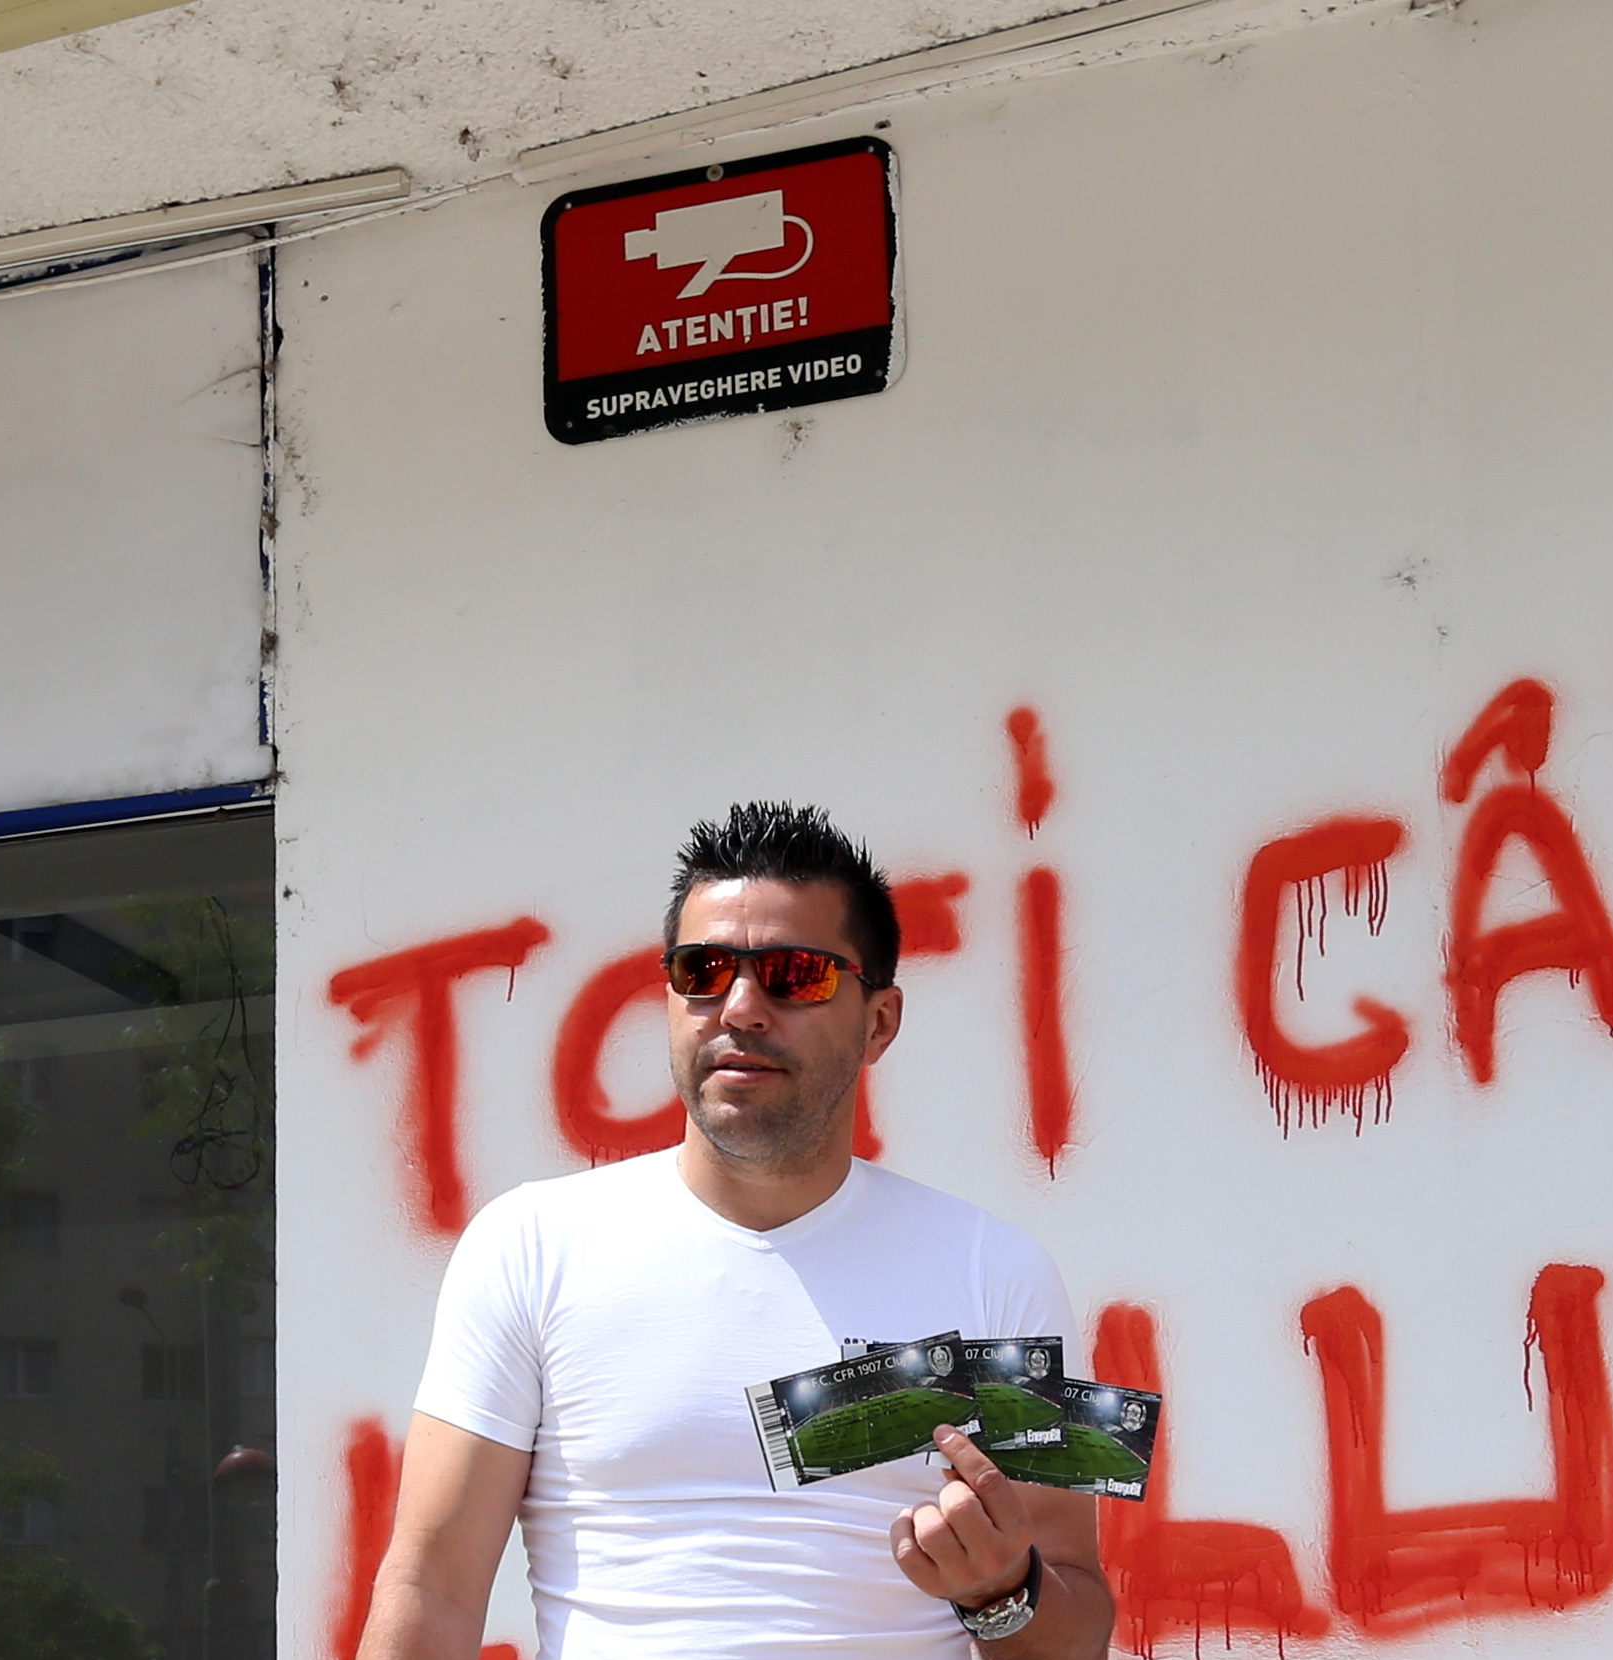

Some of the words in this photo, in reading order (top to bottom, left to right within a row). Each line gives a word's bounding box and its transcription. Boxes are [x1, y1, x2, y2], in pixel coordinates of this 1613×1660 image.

[636, 296, 809, 356] ATENȚIE!
[586, 367, 782, 420] SUPRAVEGHERE
[788, 353, 863, 385] VIDEO
[833, 1368, 856, 1383] CFR
[857, 1360, 882, 1376] 1907
[884, 1354, 908, 1369] Cluj
[965, 1347, 980, 1360] 07
[982, 1347, 1004, 1362] Cluj
[1063, 1386, 1080, 1399] 07
[1081, 1390, 1103, 1406] Cluj
